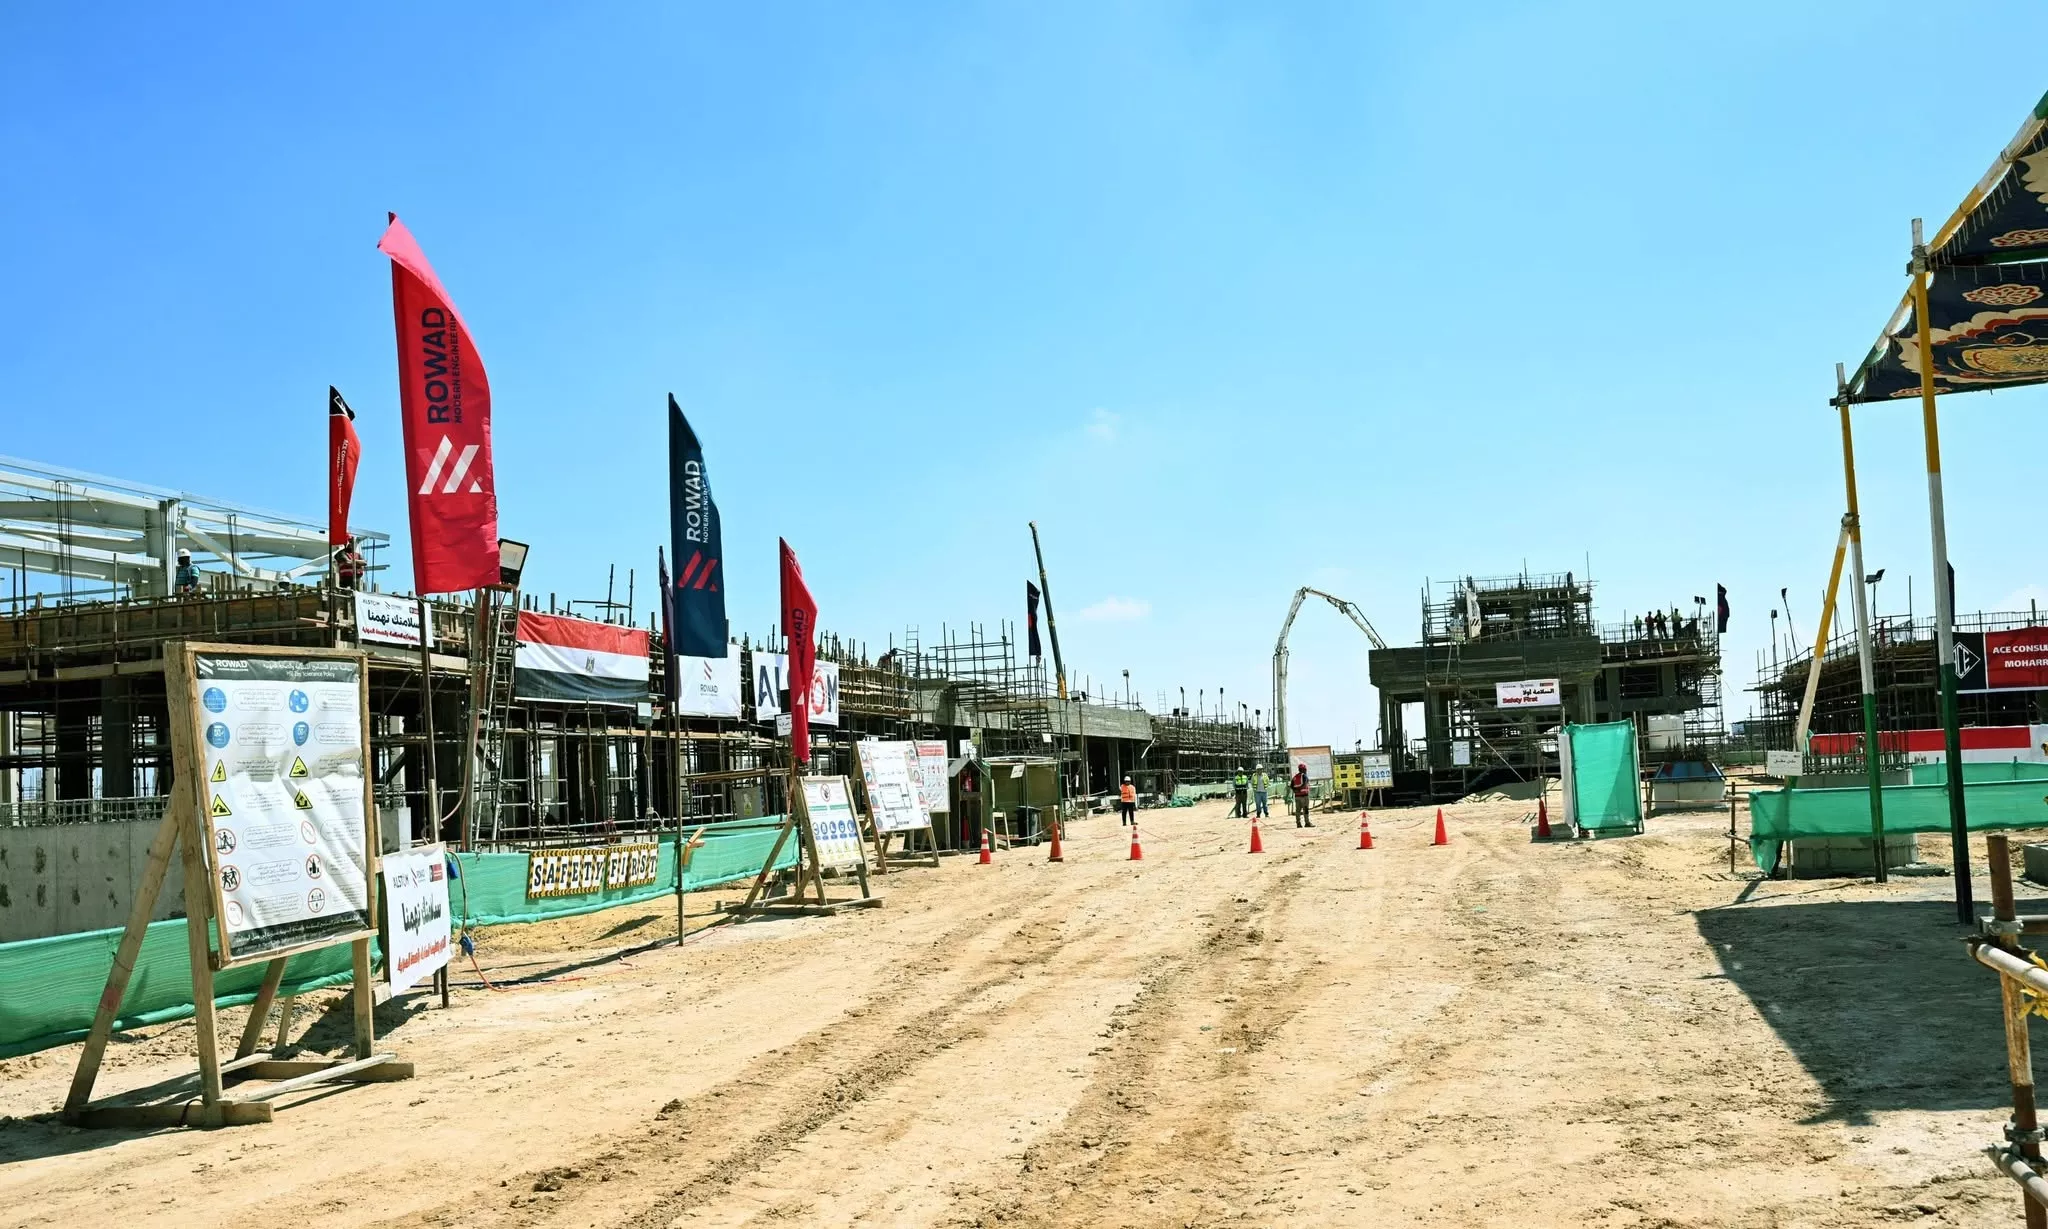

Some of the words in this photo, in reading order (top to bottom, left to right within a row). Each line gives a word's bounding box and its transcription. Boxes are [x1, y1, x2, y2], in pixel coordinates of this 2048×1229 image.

[421, 307, 450, 424] ROWAD
[452, 379, 463, 424] MODERN
[684, 460, 701, 542] ROWAD
[367, 609, 390, 626] تهمنا
[1992, 646, 2011, 654] ACE
[215, 660, 248, 668] ROWAD
[2004, 658, 2048, 668] MOHARR
[700, 683, 719, 693] ROWAD
[533, 861, 605, 887] SAFETY
[610, 855, 657, 877] FIRST
[401, 902, 421, 936] تهمنا
